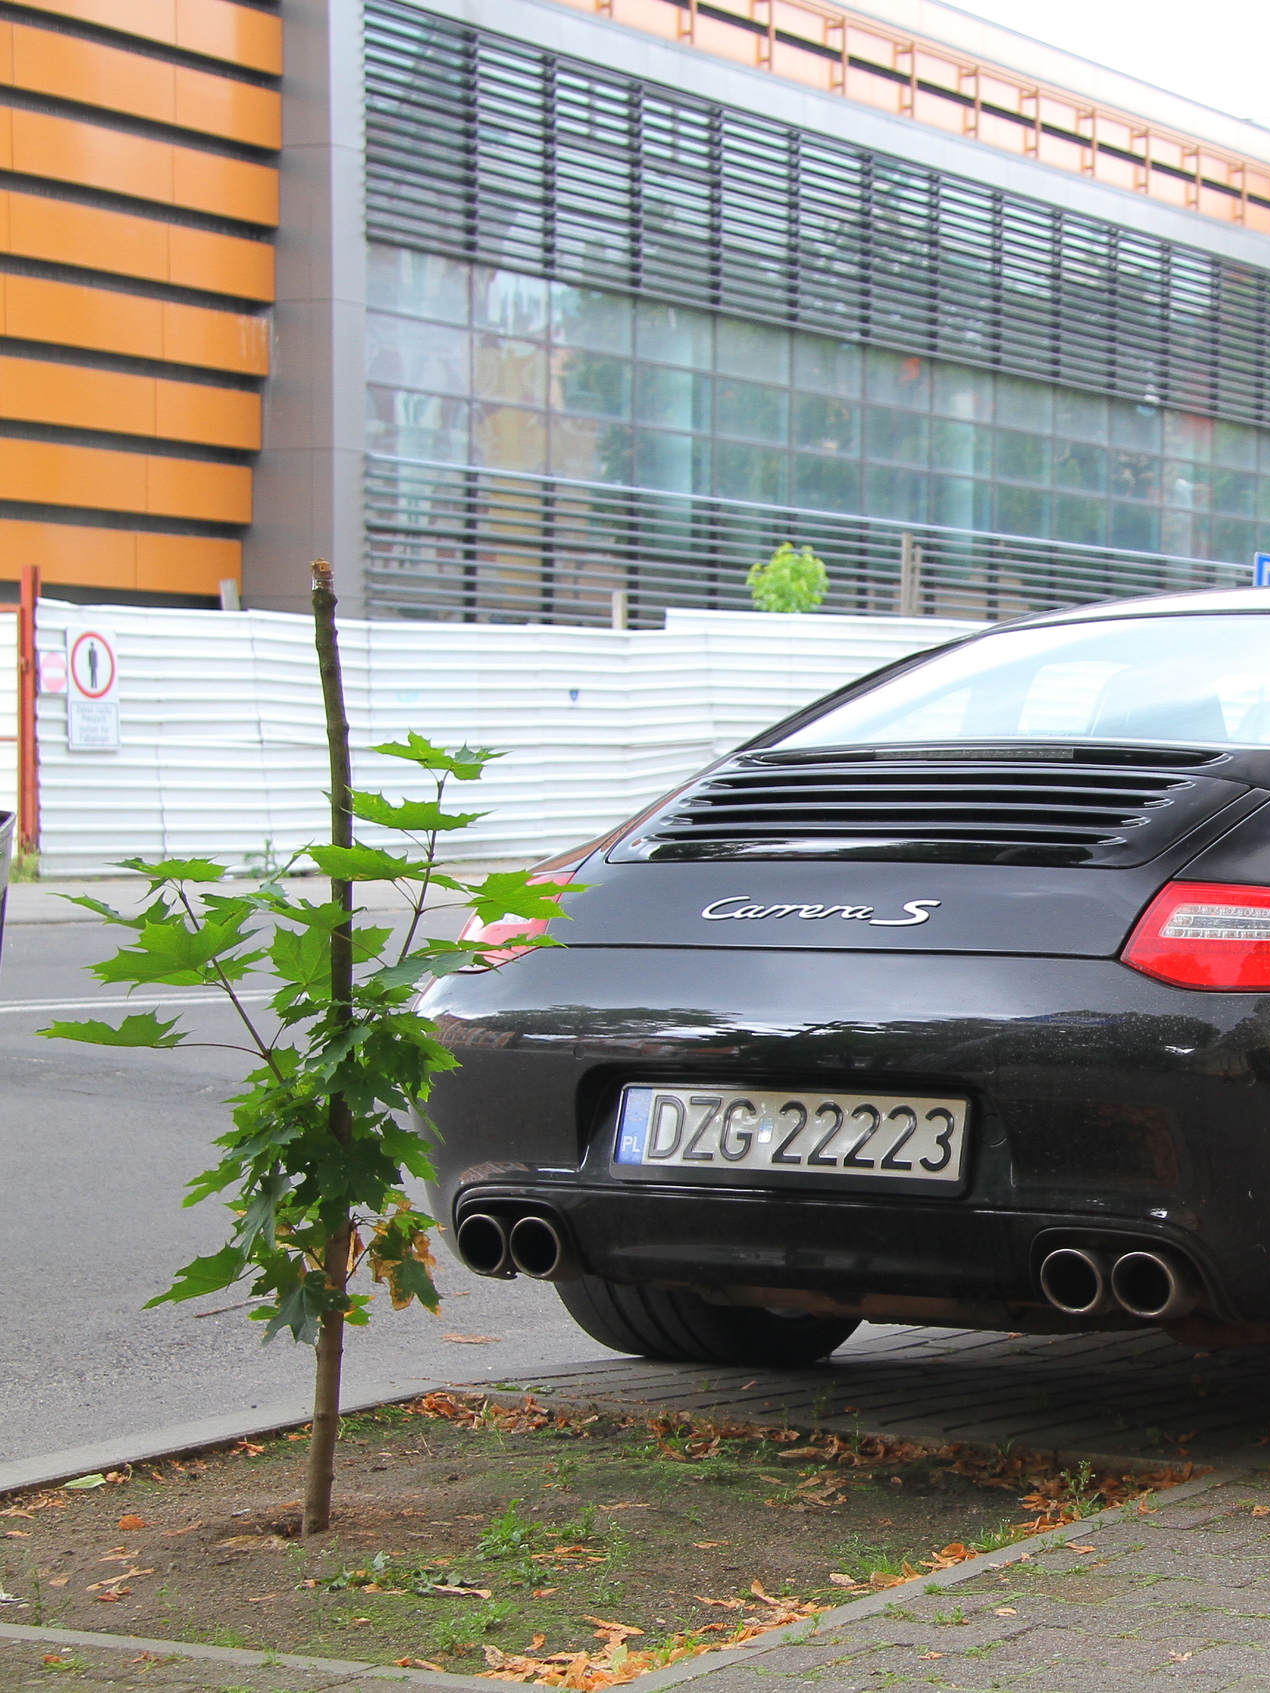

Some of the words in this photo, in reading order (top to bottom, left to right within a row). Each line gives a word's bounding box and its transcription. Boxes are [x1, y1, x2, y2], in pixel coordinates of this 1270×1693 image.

[701, 895, 874, 921] Carrera
[869, 899, 942, 927] S
[621, 1135, 641, 1153] PL
[647, 1093, 757, 1161] DZG
[771, 1099, 955, 1172] 22223
